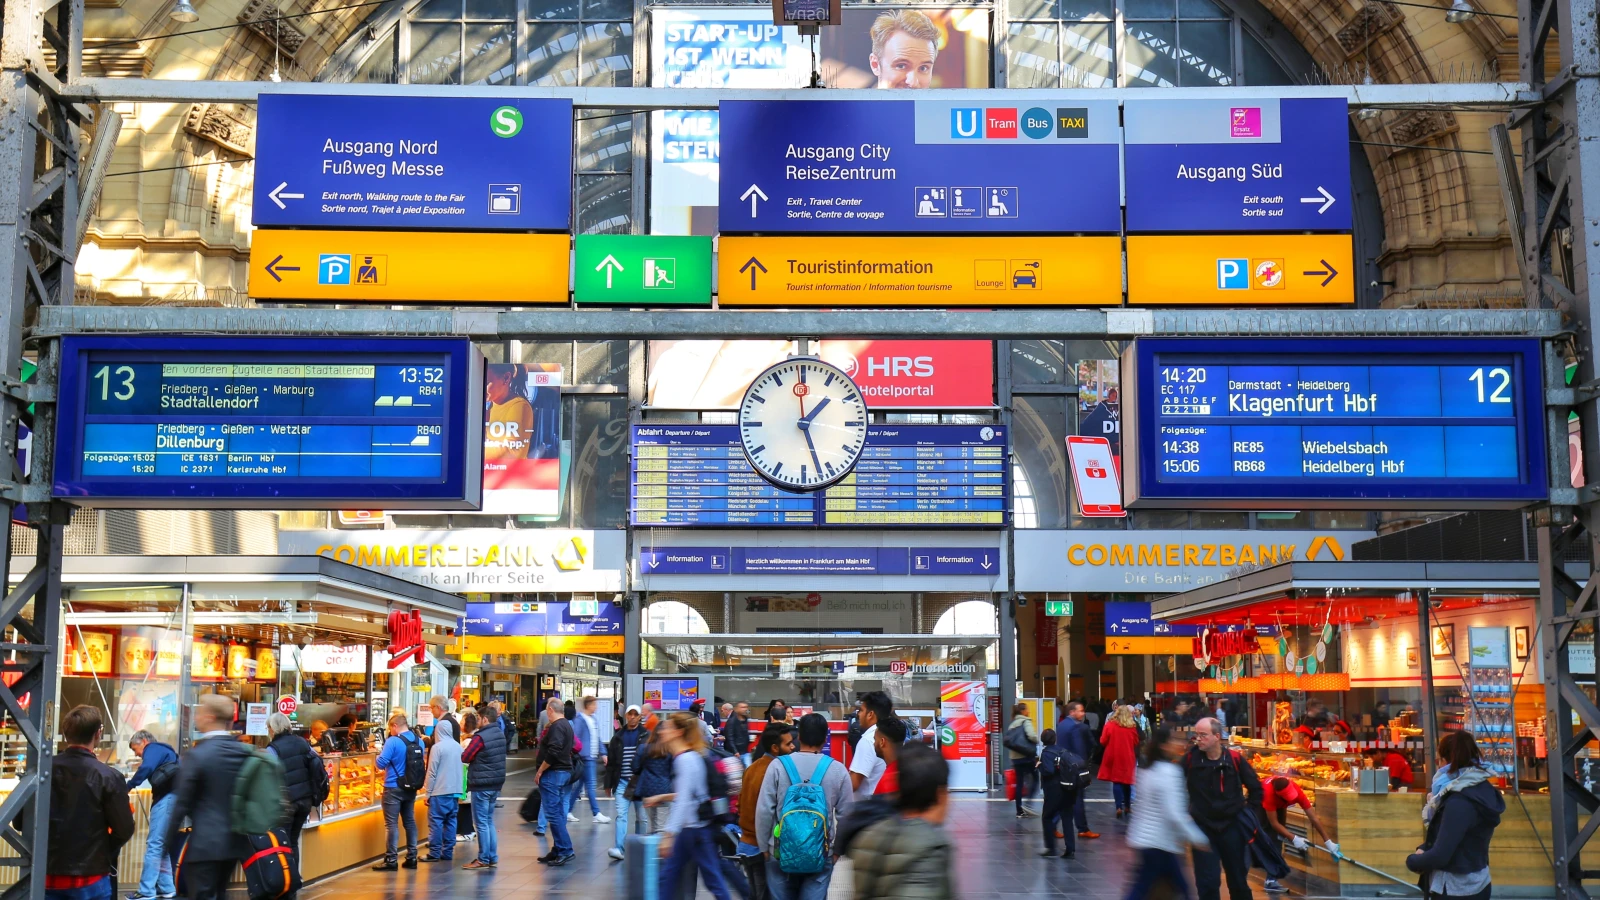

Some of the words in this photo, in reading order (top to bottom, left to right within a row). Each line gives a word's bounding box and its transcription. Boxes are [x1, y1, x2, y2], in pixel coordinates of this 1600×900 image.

[667, 23, 779, 43] START-UP
[712, 47, 784, 67] WENN
[495, 108, 518, 136] S
[956, 111, 978, 138] U
[988, 118, 1017, 129] Tram
[1027, 118, 1049, 129] Bus
[1060, 118, 1085, 129] TAXI
[322, 138, 394, 157] Ausgang
[399, 138, 438, 155] Nord
[786, 144, 855, 161] Ausgang
[860, 143, 891, 161] City
[322, 159, 386, 178] Fußweg
[391, 160, 444, 177] Messe
[785, 165, 896, 180] ReiseZentrum
[1177, 164, 1246, 182] Ausgang
[1251, 163, 1283, 178] Süd
[321, 191, 337, 201] Exit
[338, 192, 364, 203] north,
[366, 192, 398, 204] Walking
[399, 193, 423, 202] route
[424, 194, 434, 202] to
[434, 193, 449, 202] the
[450, 193, 466, 202] Fair
[787, 197, 803, 207] Exit
[808, 197, 833, 207] Travel
[835, 197, 863, 207] Center
[1243, 196, 1259, 204] Exit
[1260, 196, 1284, 204] south
[321, 204, 347, 214] Sortie
[348, 204, 369, 216] nord,
[371, 205, 395, 217] Trajet
[402, 205, 422, 217] pied
[423, 206, 465, 217] Exposition
[787, 210, 813, 220] Sortie,
[815, 210, 843, 220] Centre
[844, 210, 854, 219] de
[855, 211, 885, 221] voyage
[1242, 208, 1266, 217] Sortie
[1268, 208, 1284, 217] sud
[328, 262, 344, 283] P
[787, 259, 933, 275] Touristinformation
[1219, 261, 1240, 288] P
[786, 282, 813, 291] Tourist
[815, 282, 862, 291] information
[868, 282, 914, 292] Information
[916, 282, 953, 291] tourisme
[976, 279, 1004, 290] Lounge
[182, 365, 228, 375] vorderen
[232, 365, 270, 377] Zugteile
[272, 366, 301, 375] nach
[868, 357, 934, 377] HRS
[399, 368, 443, 383] 13:52
[1161, 368, 1206, 383] 14:20
[95, 365, 136, 401] 13
[1229, 380, 1281, 390] Darmstadt
[1297, 380, 1350, 392] Heidelberg
[1468, 368, 1511, 403] 12
[161, 384, 208, 396] Friedberg
[224, 384, 259, 395] Gießen
[273, 385, 315, 397] Marburg
[419, 386, 443, 396] RB41
[860, 385, 934, 399] Hotelportal
[1161, 385, 1175, 395] EC
[1178, 385, 1196, 395] 117
[161, 395, 260, 409] Stadtallendorf
[1229, 393, 1334, 416] Klagenfurt
[1344, 393, 1377, 412] Hbf
[157, 424, 205, 436] Friedberg
[221, 424, 255, 435] Gießen
[270, 425, 312, 435] Wetzlar
[417, 425, 441, 436] RB40
[637, 428, 663, 436] Abfahrt
[665, 429, 690, 437] Departure
[1161, 426, 1207, 435] Folgezüge:
[156, 436, 225, 451] Dillenburg
[1162, 441, 1200, 454] 14:38
[1233, 441, 1264, 453] RE85
[1302, 440, 1388, 454] Wiebelsbach
[84, 453, 131, 462] Folgezüge:
[181, 454, 195, 462] ICE
[198, 454, 219, 462] 1631
[228, 454, 252, 462] Berlin
[259, 454, 274, 462] Hbf
[132, 465, 155, 473] 15:20
[180, 465, 190, 473] IC
[192, 465, 213, 473] 2371
[227, 465, 269, 473] Karlsruhe
[272, 465, 287, 473] Hbf
[1162, 460, 1200, 473] 15:06
[1234, 460, 1265, 472] RB68
[1302, 459, 1374, 476] Heidelberg
[1381, 459, 1405, 473] Hbf
[666, 555, 704, 563] Information
[746, 557, 768, 565] Herzlich
[769, 557, 803, 565] willkommen
[936, 555, 974, 563] Information
[1067, 543, 1297, 566] COMMERZBANK
[443, 575, 461, 585] an
[466, 572, 503, 585] Ihrer
[507, 571, 545, 585] Seite
[1125, 572, 1148, 584] Die
[1154, 572, 1191, 585] Bank
[892, 663, 907, 673] DB
[912, 662, 976, 674] Information
